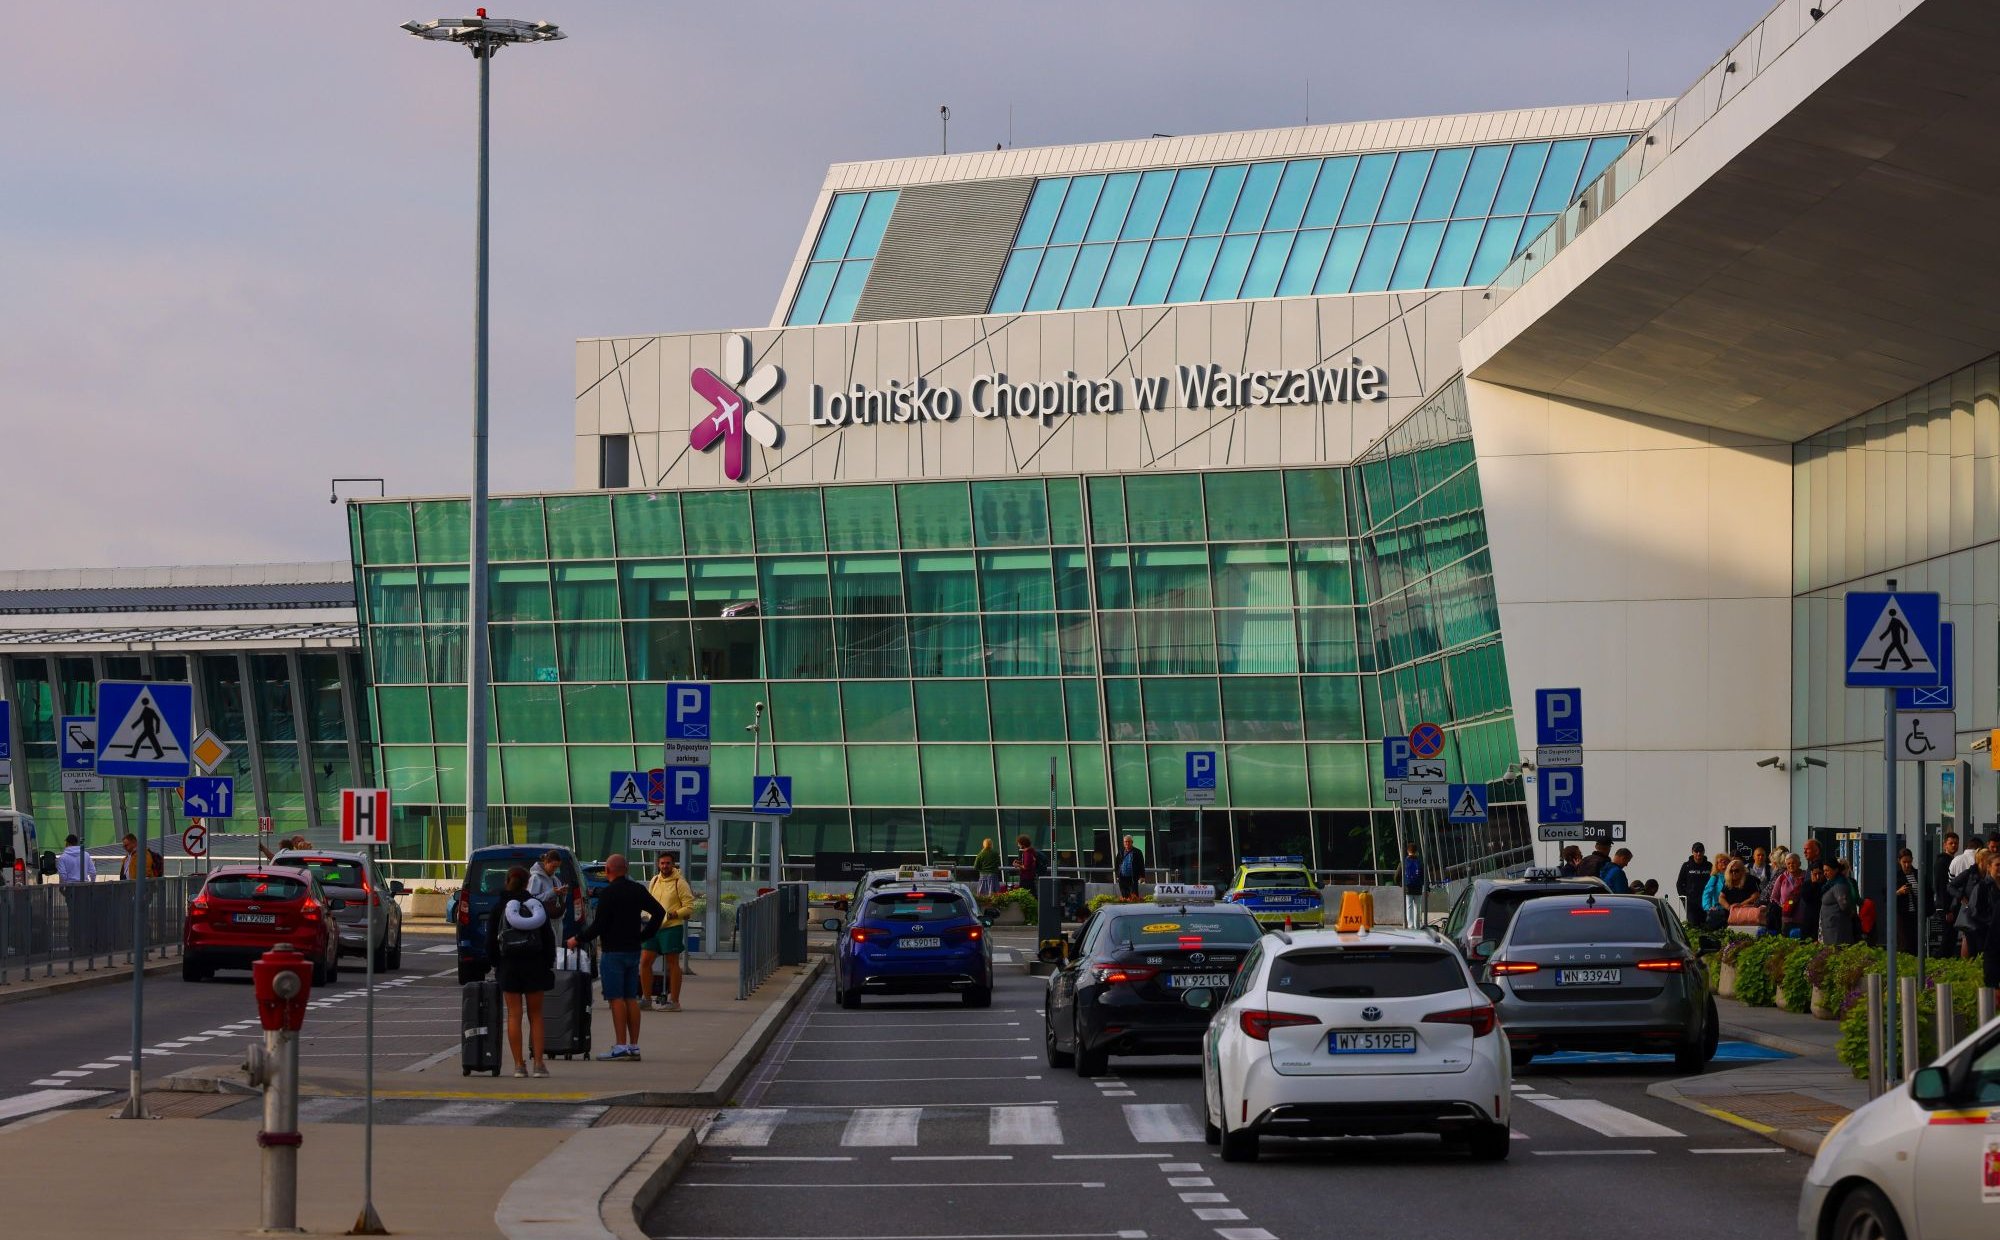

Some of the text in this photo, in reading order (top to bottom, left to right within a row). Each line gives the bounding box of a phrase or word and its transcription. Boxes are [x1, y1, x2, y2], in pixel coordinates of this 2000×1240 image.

[809, 356, 1381, 426] Lotnisko Chopina w Warszawie
[676, 688, 702, 723] P
[1546, 693, 1572, 728] P
[677, 743, 709, 753] Dyspozytora
[1391, 740, 1411, 767] P
[1193, 754, 1210, 778] P
[675, 770, 700, 805] P
[1548, 772, 1574, 807] P
[356, 796, 374, 835] H
[670, 827, 704, 836] Koniec
[1544, 828, 1579, 837] Koniec
[632, 838, 681, 848] Strefa ruchu
[1531, 869, 1557, 877] TAXI
[1159, 885, 1184, 894] TAXI
[1344, 915, 1363, 924] TAXI
[1172, 975, 1226, 986] WY 921CK
[1564, 969, 1619, 982] WN 3394V
[1340, 1034, 1411, 1049] WY 519EP
